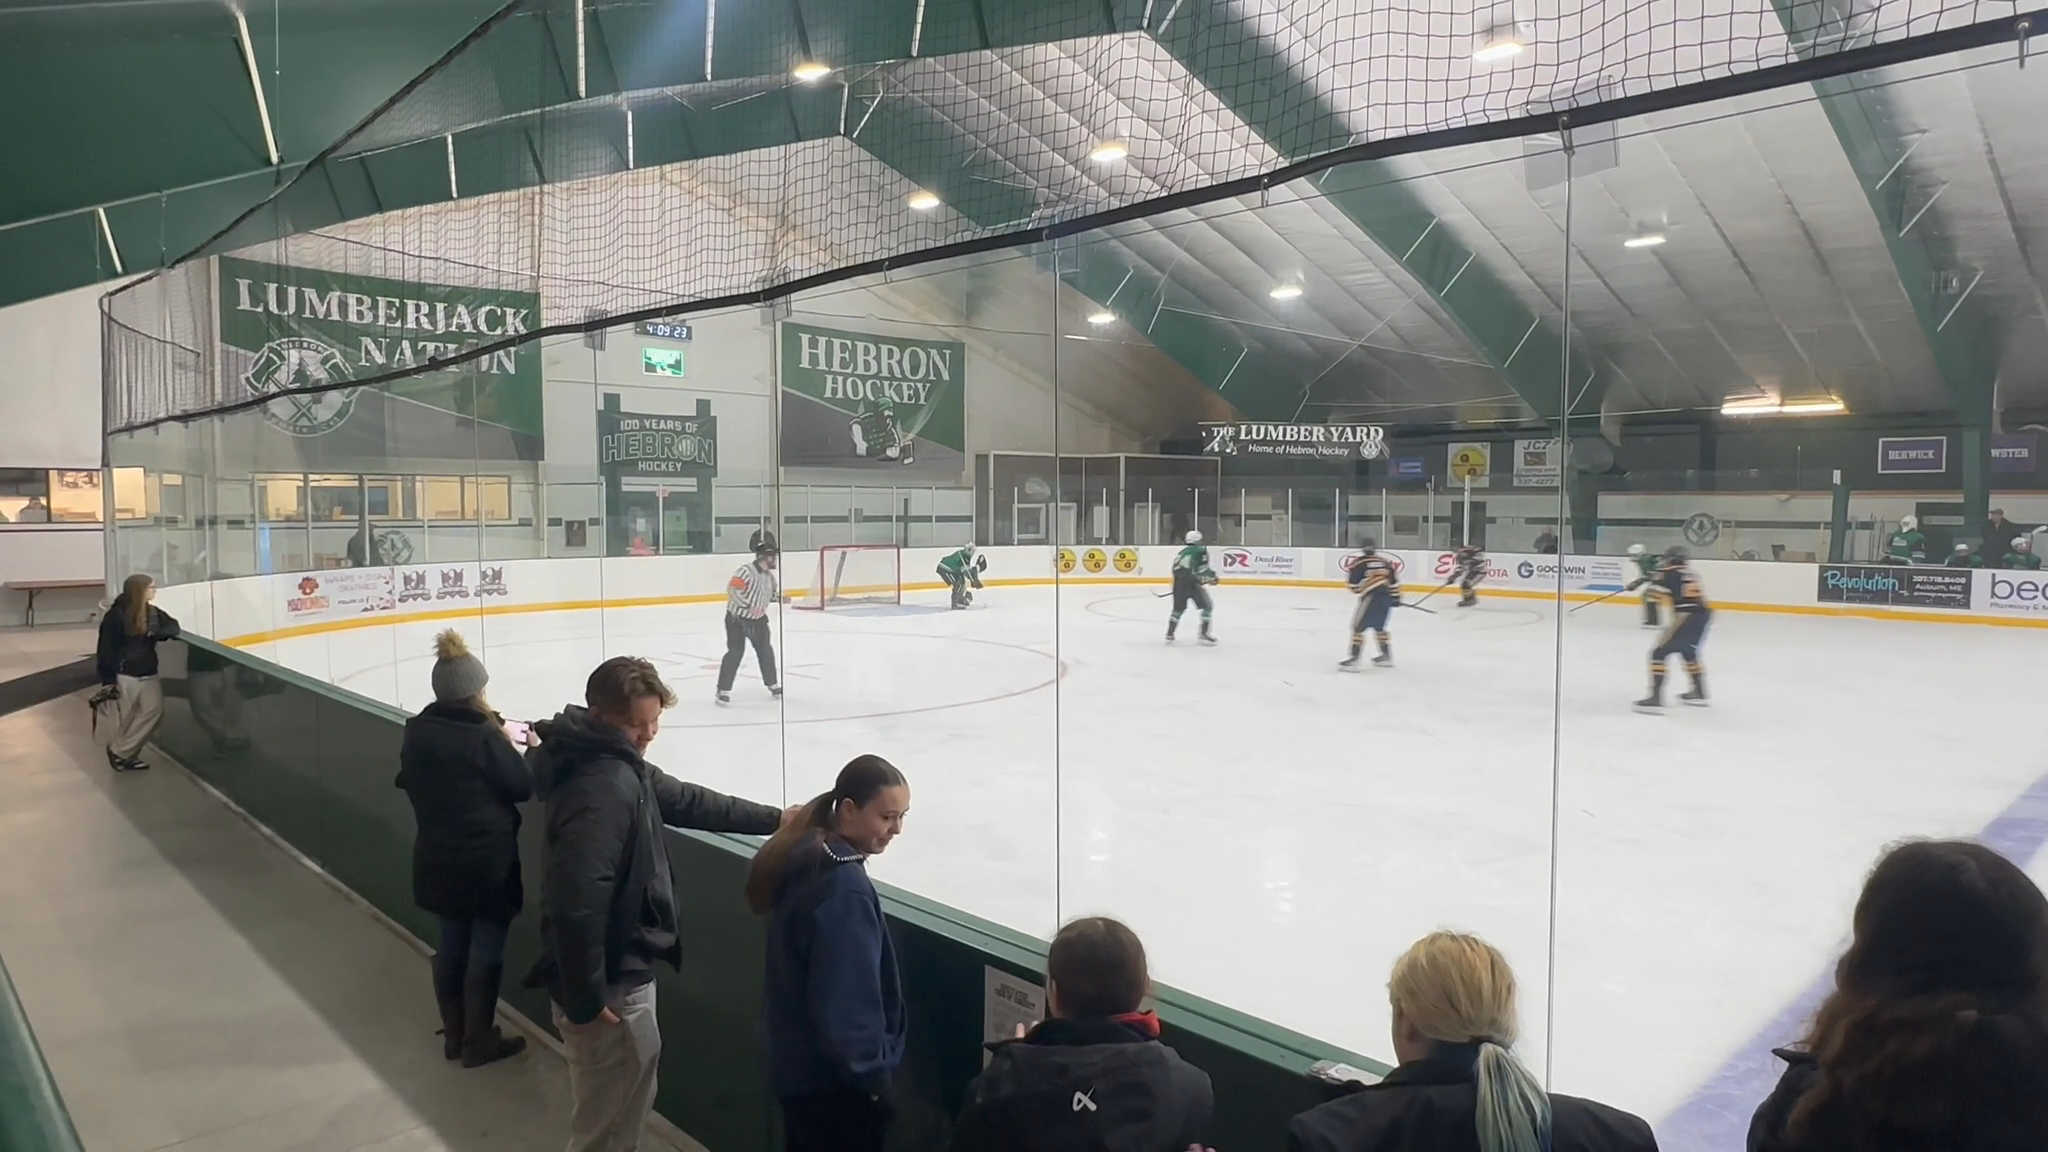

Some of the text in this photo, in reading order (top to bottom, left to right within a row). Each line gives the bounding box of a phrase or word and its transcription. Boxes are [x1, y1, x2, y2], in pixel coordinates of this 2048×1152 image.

[235, 278, 530, 335] LUMBERJACK
[646, 323, 687, 338] 4:09:23
[798, 332, 952, 381] HEBRON
[823, 374, 931, 405] HOCKEY
[620, 419, 699, 434] 100 YEARS OF
[1211, 424, 1384, 443] THE LUMBER YARD
[603, 431, 714, 466] HEBRON
[1248, 444, 1350, 457] Home of Hebron Hockey
[1888, 449, 1935, 460] BERWICK
[1991, 448, 2029, 458] WSTER
[638, 461, 682, 472] HOCKEY
[1254, 555, 1274, 563] Dead
[1536, 565, 1586, 575] GOOWIN
[325, 574, 356, 584] WRAPS
[1823, 570, 1900, 592] Revolution
[338, 582, 378, 592] GRAPHICS
[1915, 583, 1948, 591] Auburn,
[1990, 602, 2030, 611] Pharmacy
